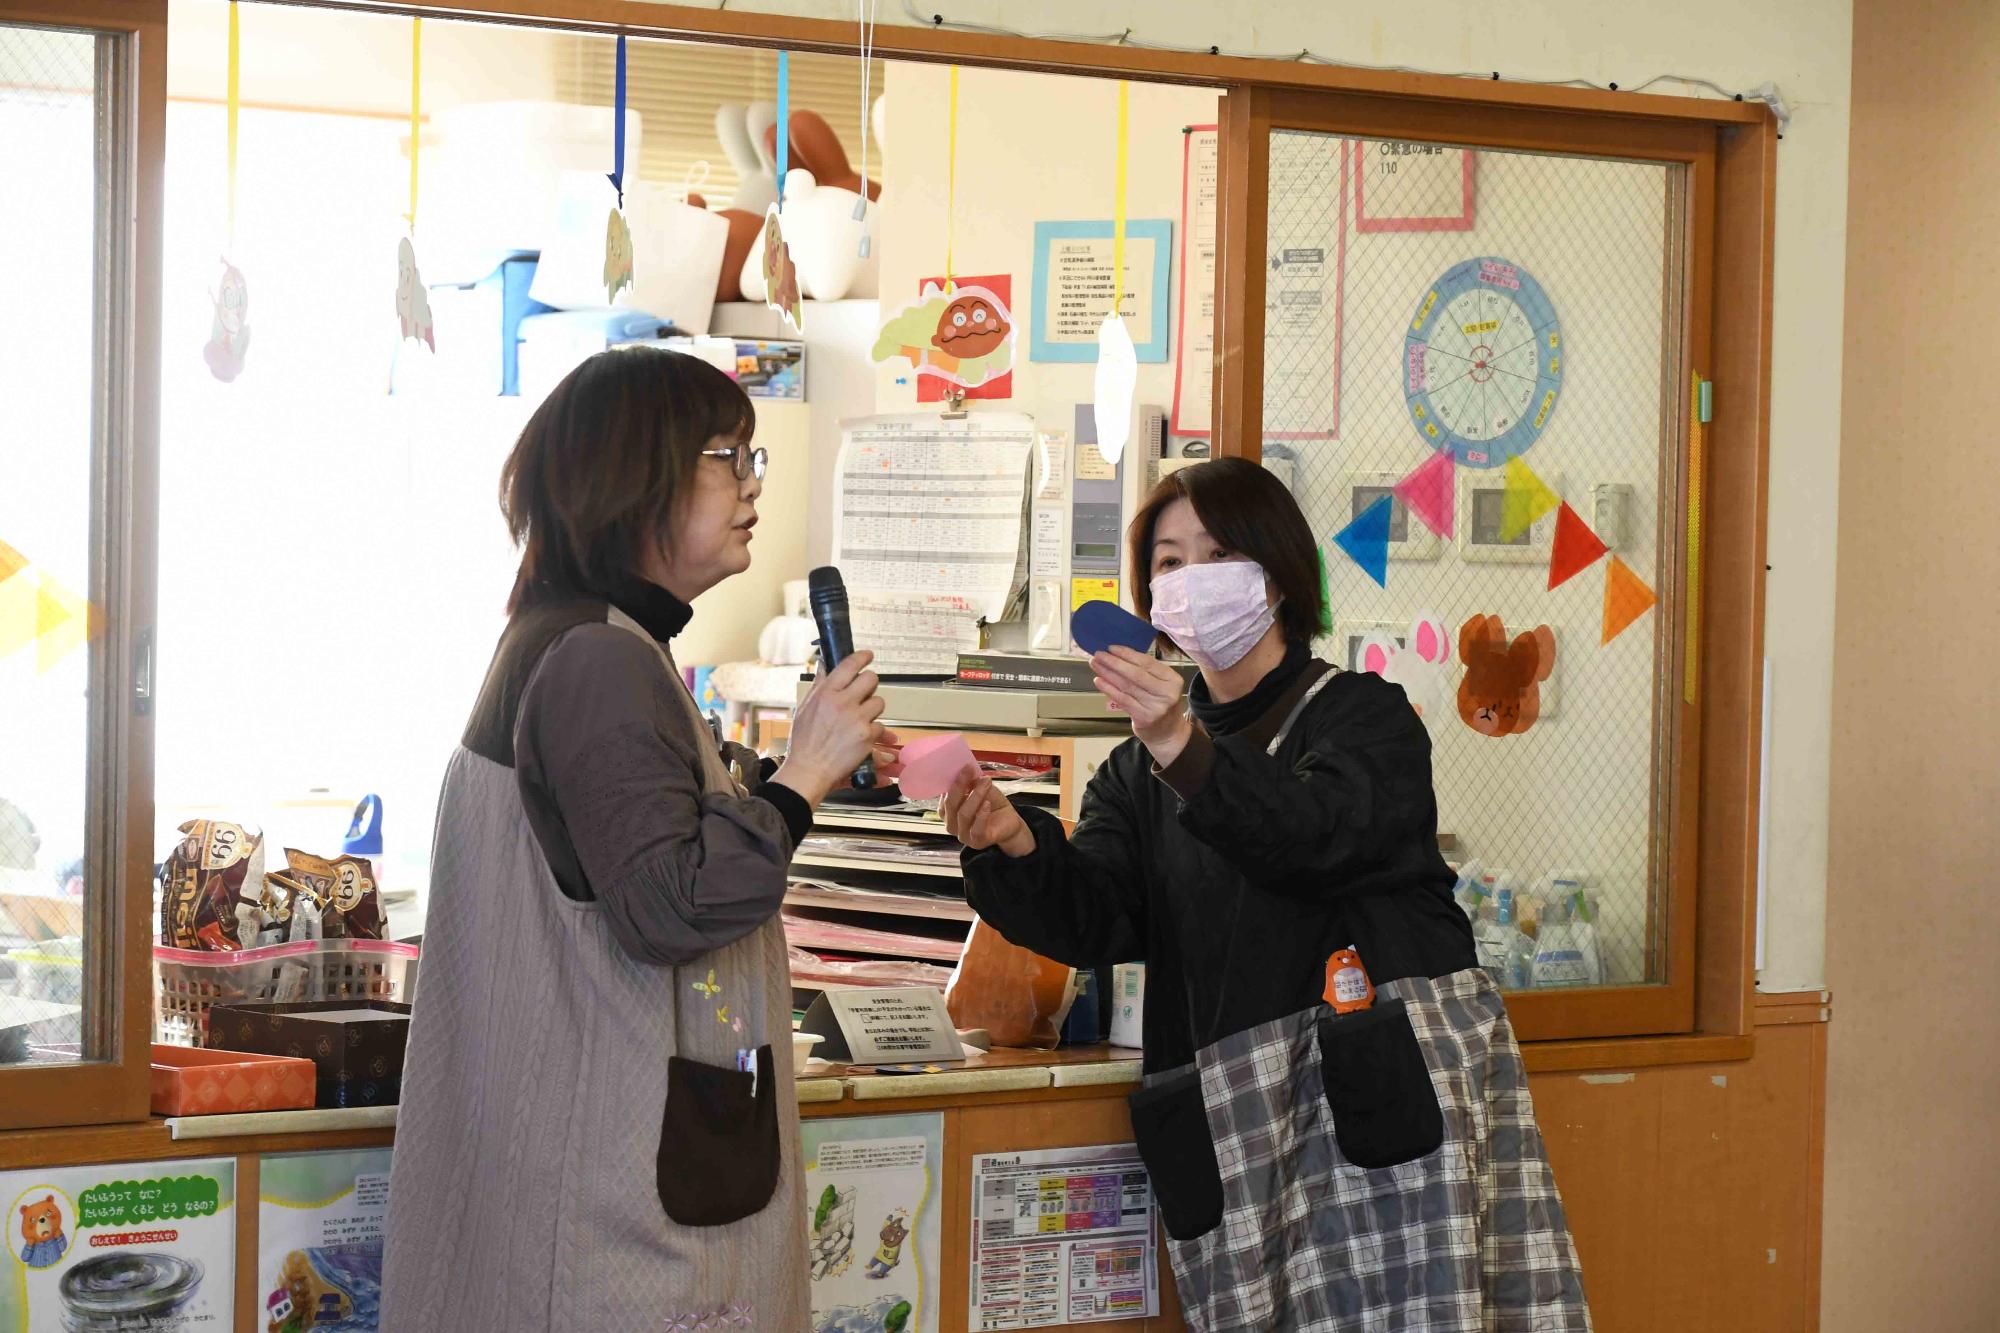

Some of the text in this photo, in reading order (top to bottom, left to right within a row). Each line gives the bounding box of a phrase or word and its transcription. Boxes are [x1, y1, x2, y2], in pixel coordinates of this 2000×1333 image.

[1381, 161, 1397, 174] 110
[84, 1190, 132, 1204] たいふうって
[84, 1206, 125, 1219] たいふうが
[131, 1204, 155, 1216] くると
[162, 1202, 178, 1213] どう
